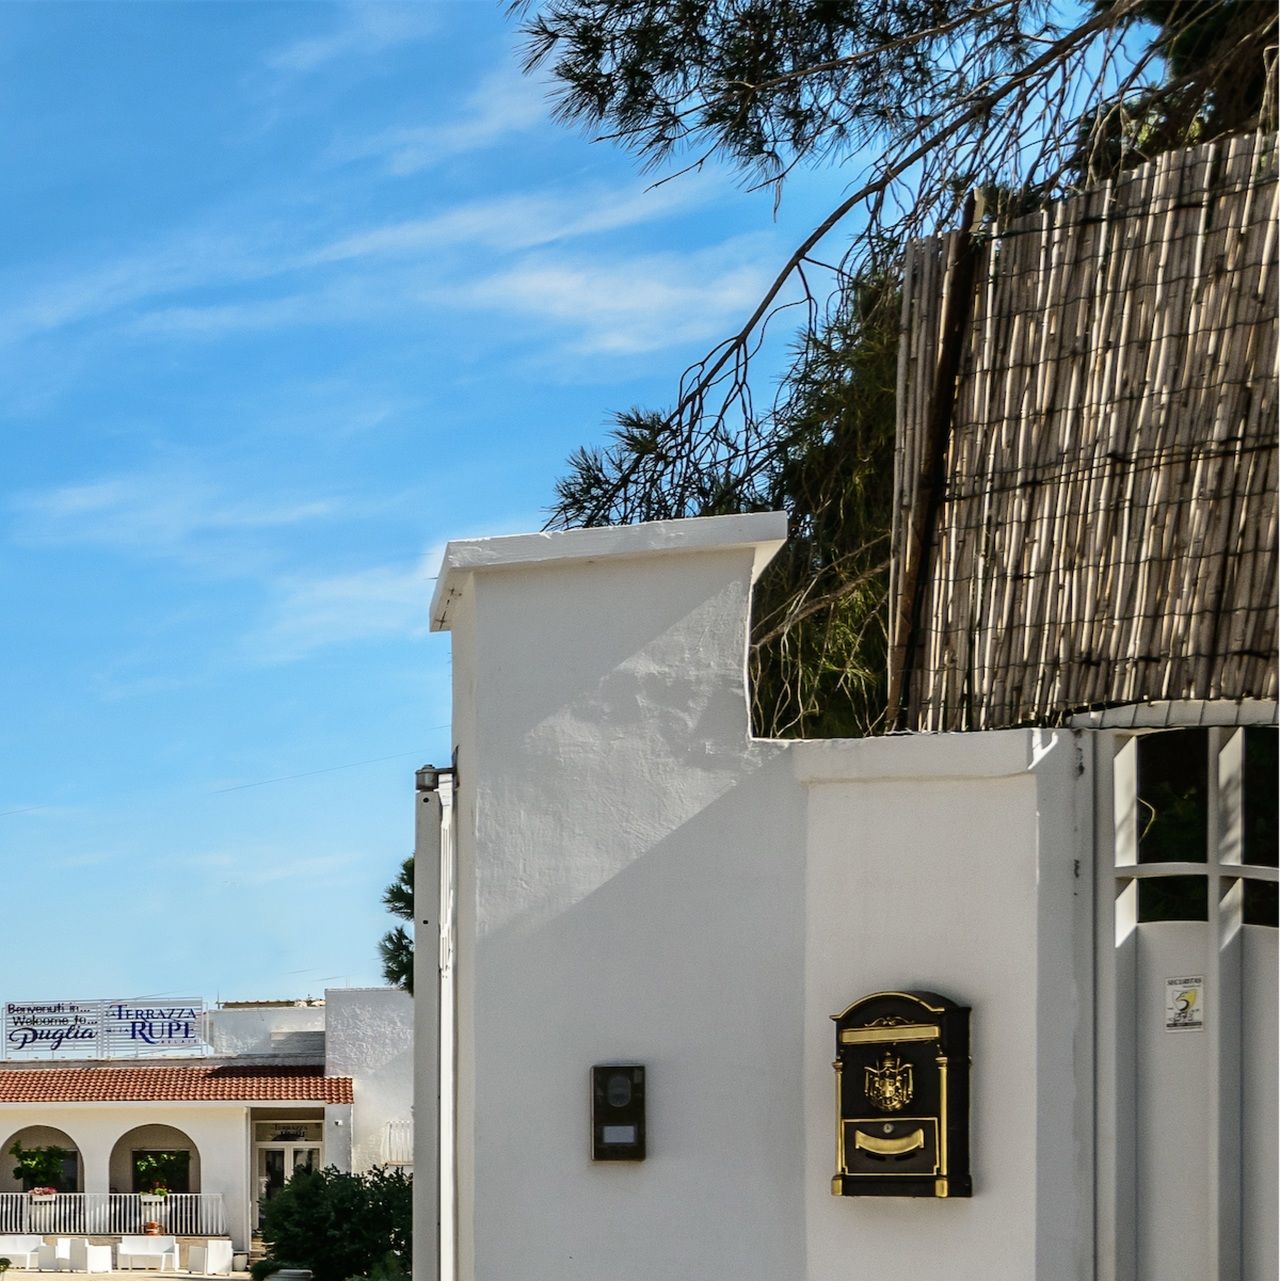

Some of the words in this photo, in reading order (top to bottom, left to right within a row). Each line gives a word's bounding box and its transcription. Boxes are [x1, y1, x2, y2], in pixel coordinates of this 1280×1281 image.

[7, 1003, 65, 1014] Benvenuti
[13, 1015, 69, 1026] Welcome
[9, 1024, 98, 1050] Puglia
